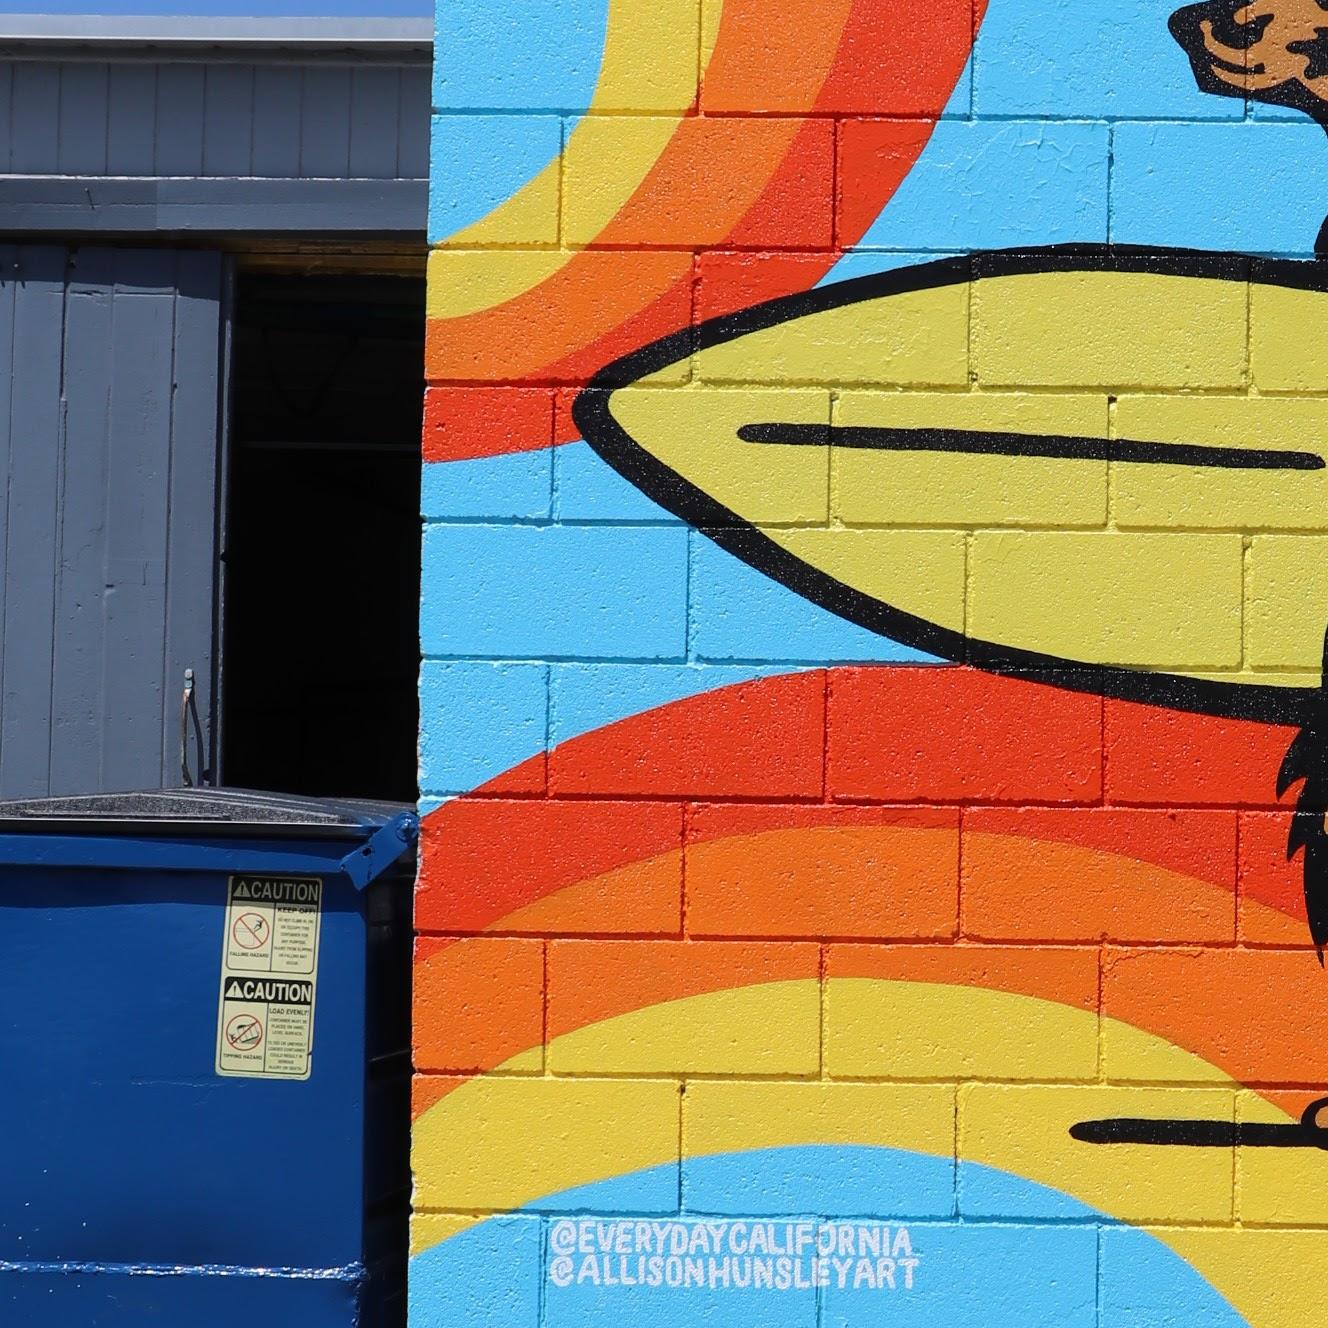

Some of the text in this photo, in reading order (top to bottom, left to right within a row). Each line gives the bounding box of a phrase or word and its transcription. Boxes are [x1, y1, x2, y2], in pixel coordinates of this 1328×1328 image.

[251, 881, 318, 901] CAUTION
[243, 980, 311, 1002] CAUTION
[550, 1220, 913, 1257] @EVERYDAYCALIFORNIA
[549, 1254, 919, 1290] @ALLISONHUNSLEYART
